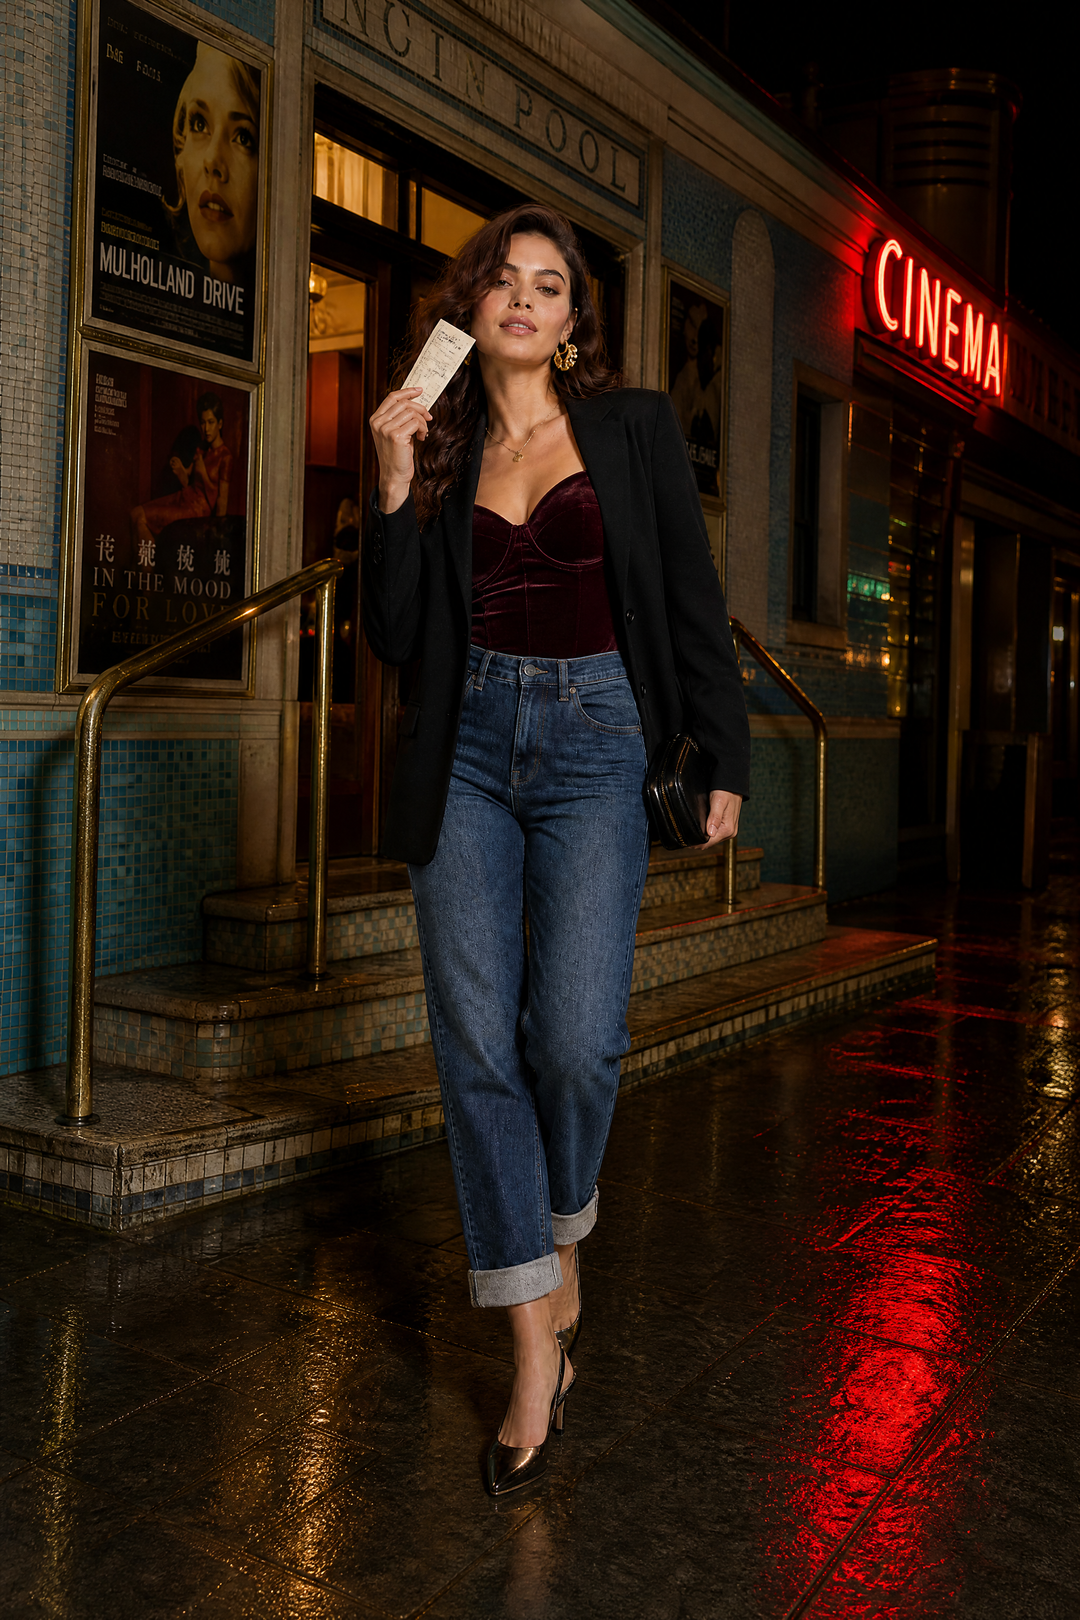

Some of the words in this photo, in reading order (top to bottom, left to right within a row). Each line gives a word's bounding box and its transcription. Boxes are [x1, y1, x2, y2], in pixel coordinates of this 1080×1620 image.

[514, 83, 627, 193] POOL
[100, 241, 195, 299] MULHOLLAND
[202, 275, 245, 316] DRIVE
[876, 239, 1000, 396] CINEMA
[92, 567, 115, 588] IN
[123, 570, 164, 593] THE
[173, 575, 231, 600] MOOD
[92, 591, 150, 620] FOR
